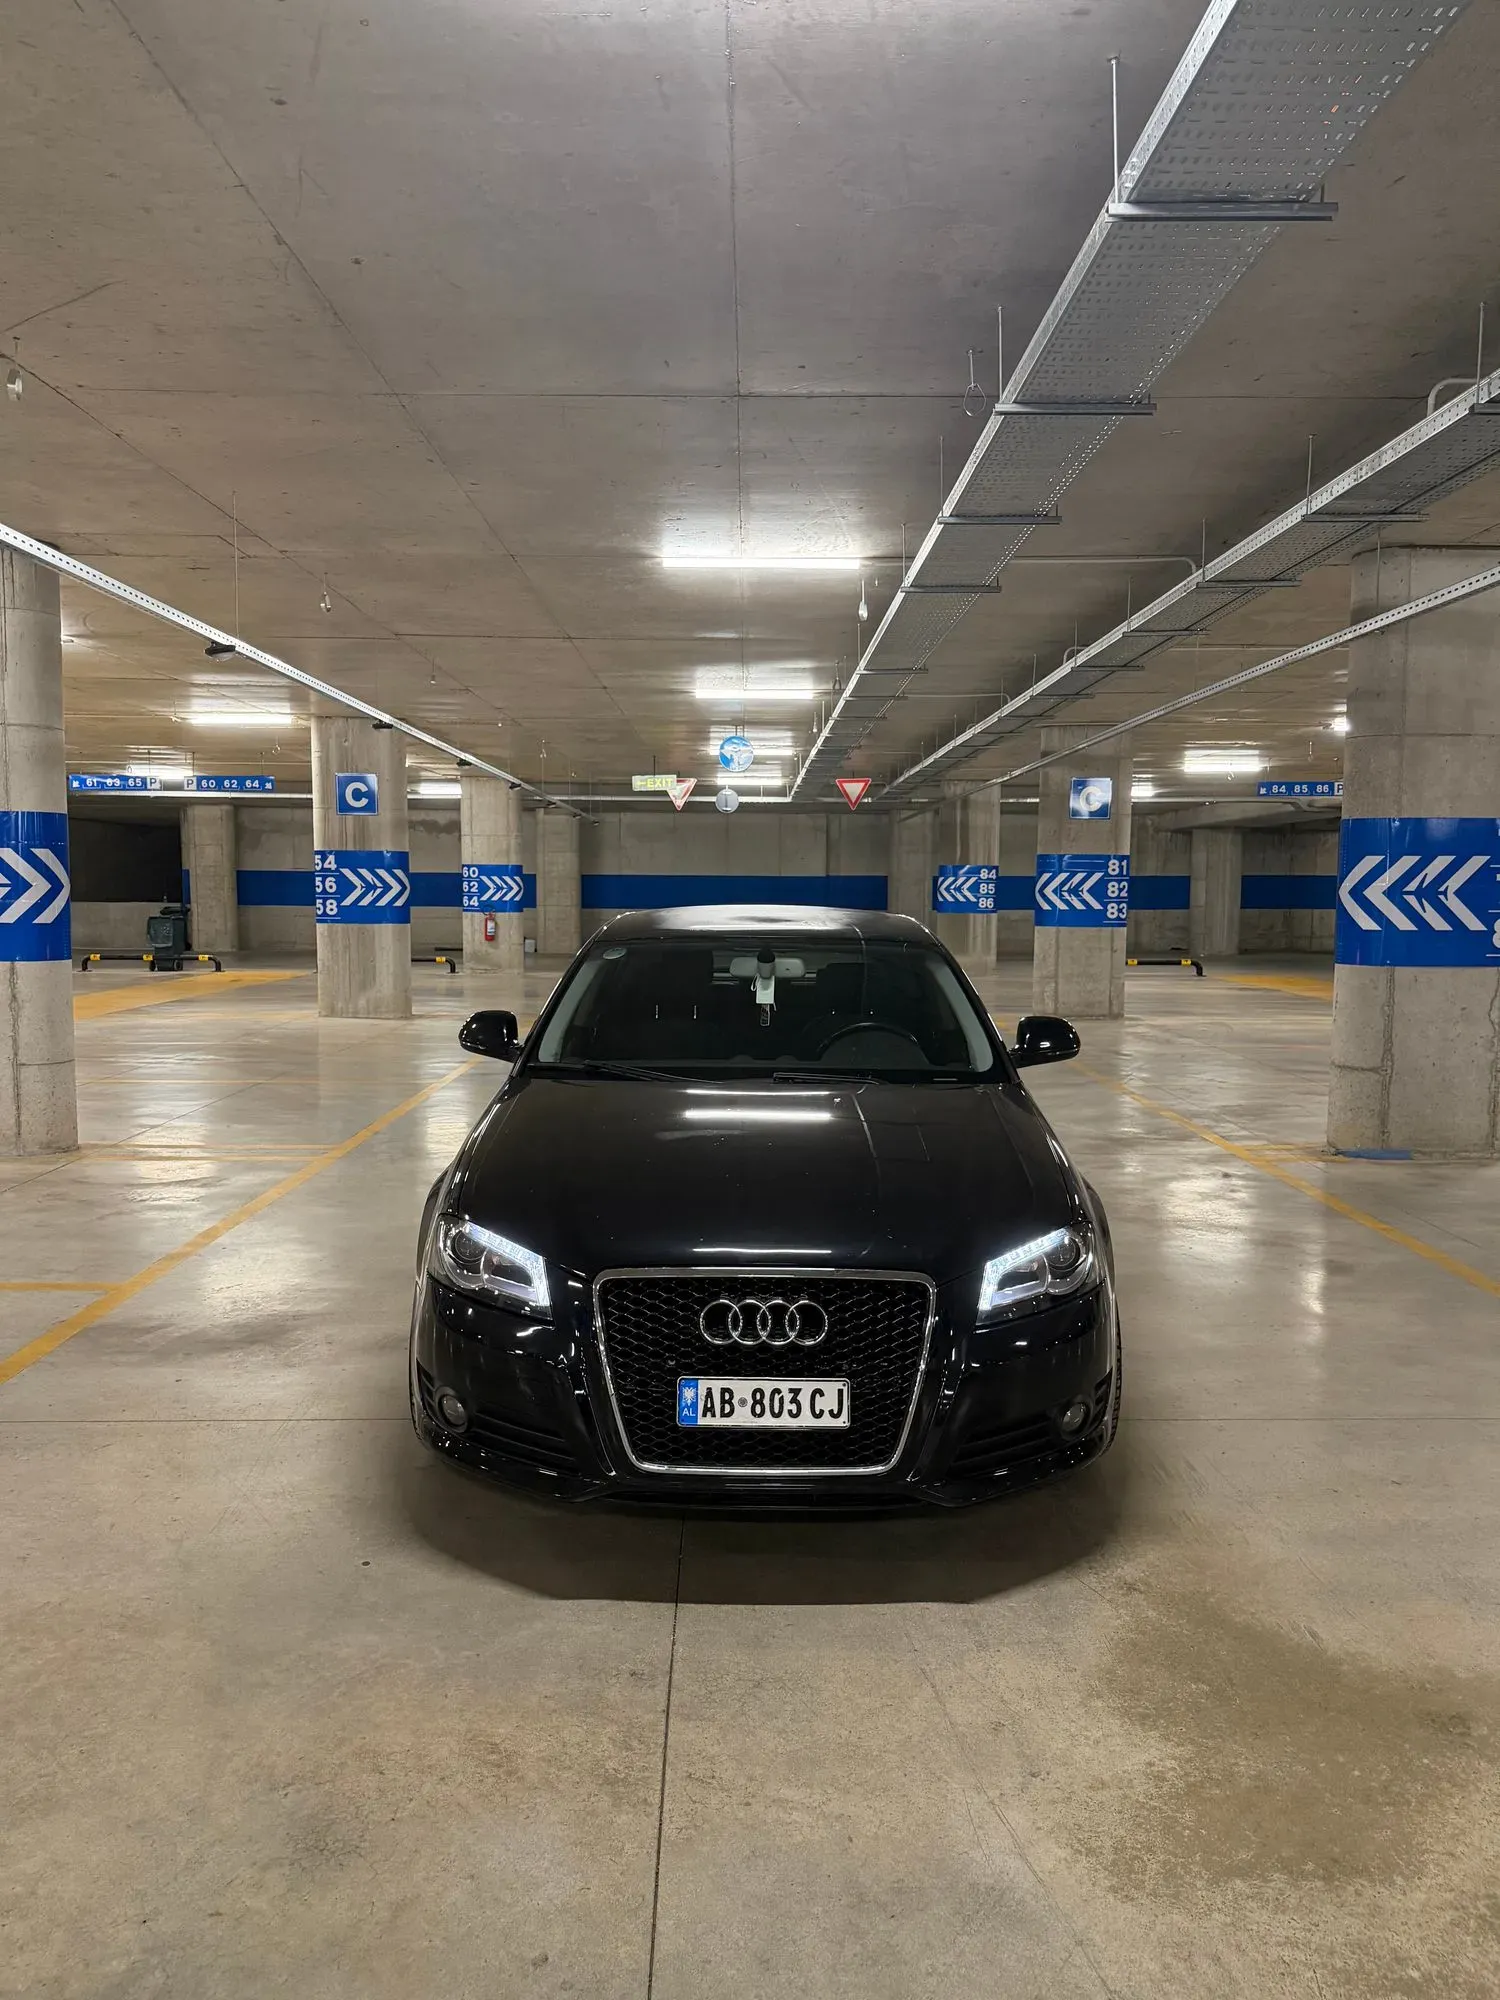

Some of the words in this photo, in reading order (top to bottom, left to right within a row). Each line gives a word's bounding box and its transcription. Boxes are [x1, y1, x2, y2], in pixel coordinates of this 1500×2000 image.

[86, 779, 98, 787] 61
[128, 779, 142, 787] 65
[149, 778, 157, 788] P
[187, 778, 194, 789] P
[201, 779, 216, 788] 60
[223, 779, 238, 788] 62
[245, 779, 260, 788] 64
[647, 778, 673, 788] EXIT
[1272, 785, 1286, 793] 84
[1294, 785, 1308, 793] 85
[1316, 784, 1329, 793] 86
[345, 782, 369, 808] C
[1080, 786, 1102, 812] C
[314, 854, 337, 871] 54
[1107, 859, 1127, 876] 81
[462, 866, 479, 878] 60
[980, 868, 996, 880] 84
[315, 877, 337, 893] 56
[462, 881, 479, 892] 62
[979, 883, 996, 894] 85
[1107, 881, 1128, 898] 82
[462, 895, 479, 907] 64
[978, 897, 994, 909] 86
[316, 899, 338, 916] 58
[1106, 902, 1127, 919] 83
[701, 1387, 735, 1419] AB
[750, 1387, 803, 1419] 803
[809, 1387, 844, 1420] CJ
[682, 1409, 696, 1417] AL
